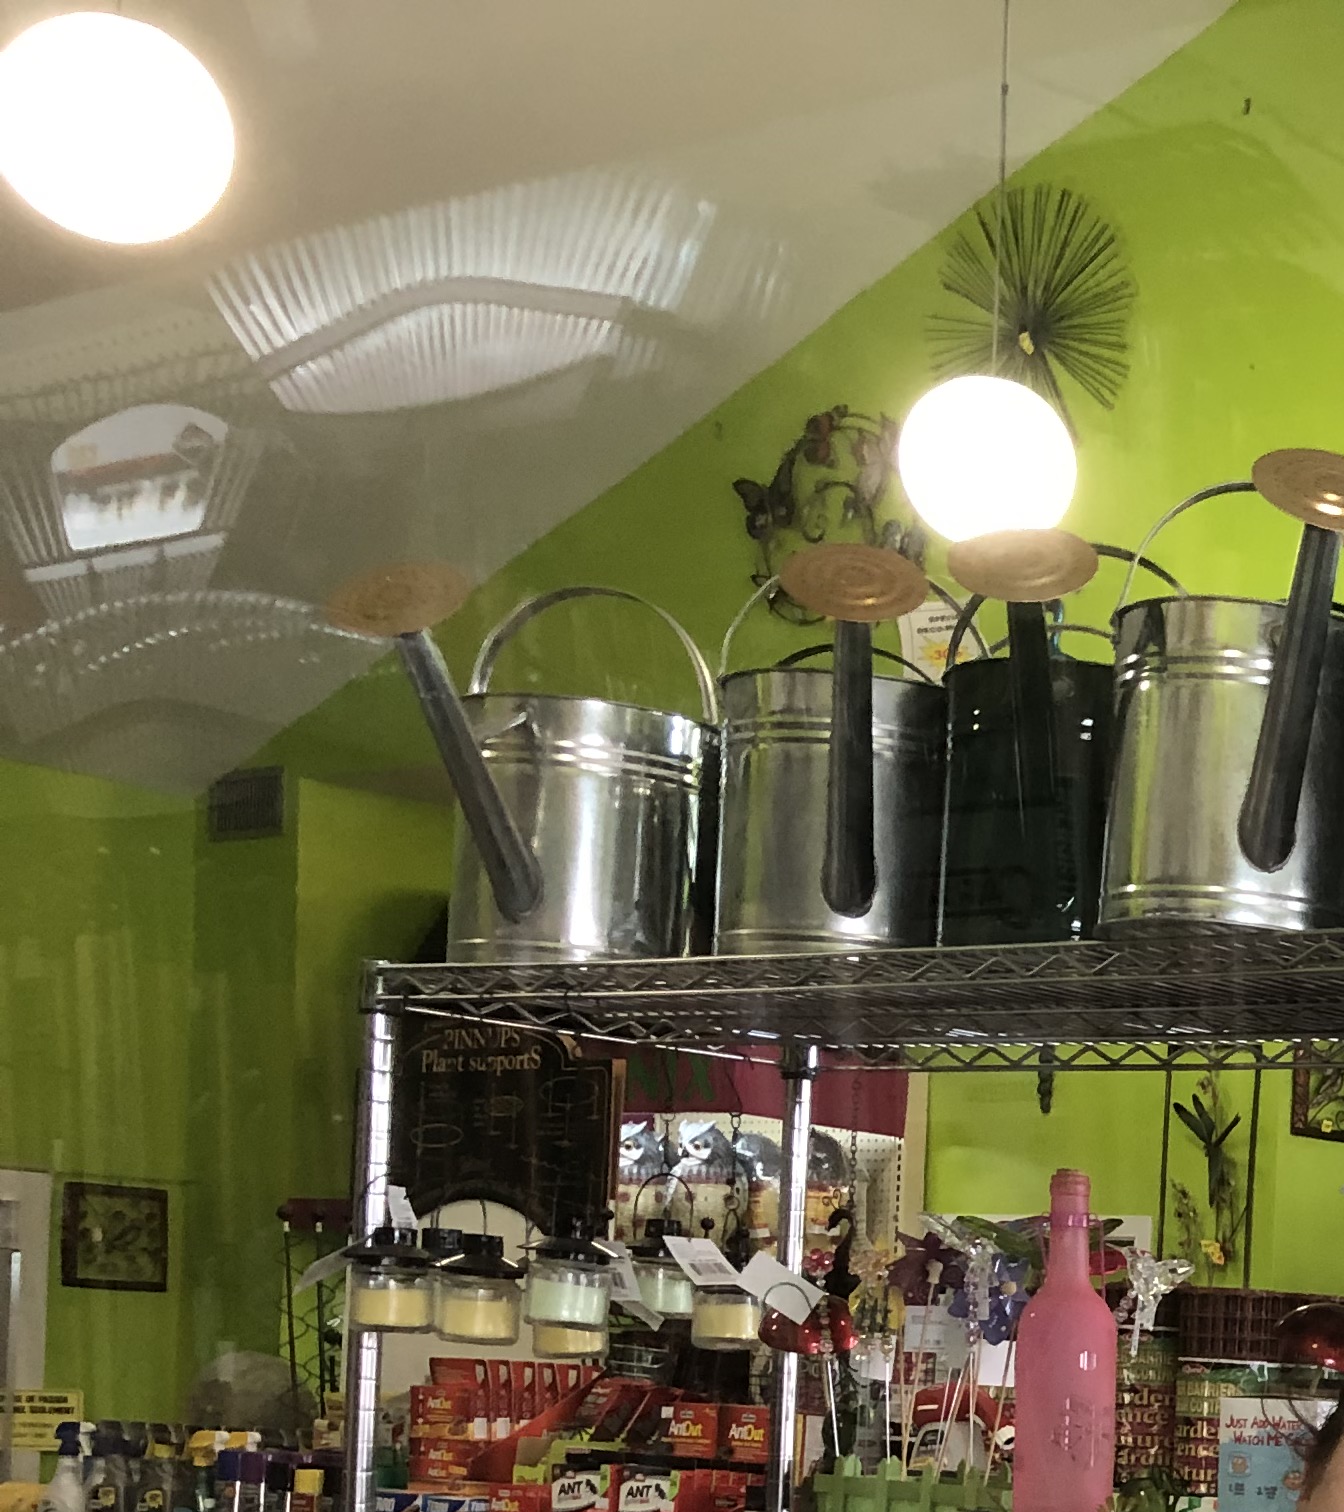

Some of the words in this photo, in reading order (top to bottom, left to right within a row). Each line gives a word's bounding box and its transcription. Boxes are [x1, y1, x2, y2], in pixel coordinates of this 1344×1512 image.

[1224, 1417, 1248, 1430] JUST
[1232, 1431, 1264, 1447] WATCH
[1265, 1432, 1283, 1447] ME
[556, 1483, 586, 1498] ANT
[626, 1485, 653, 1499] ANT
